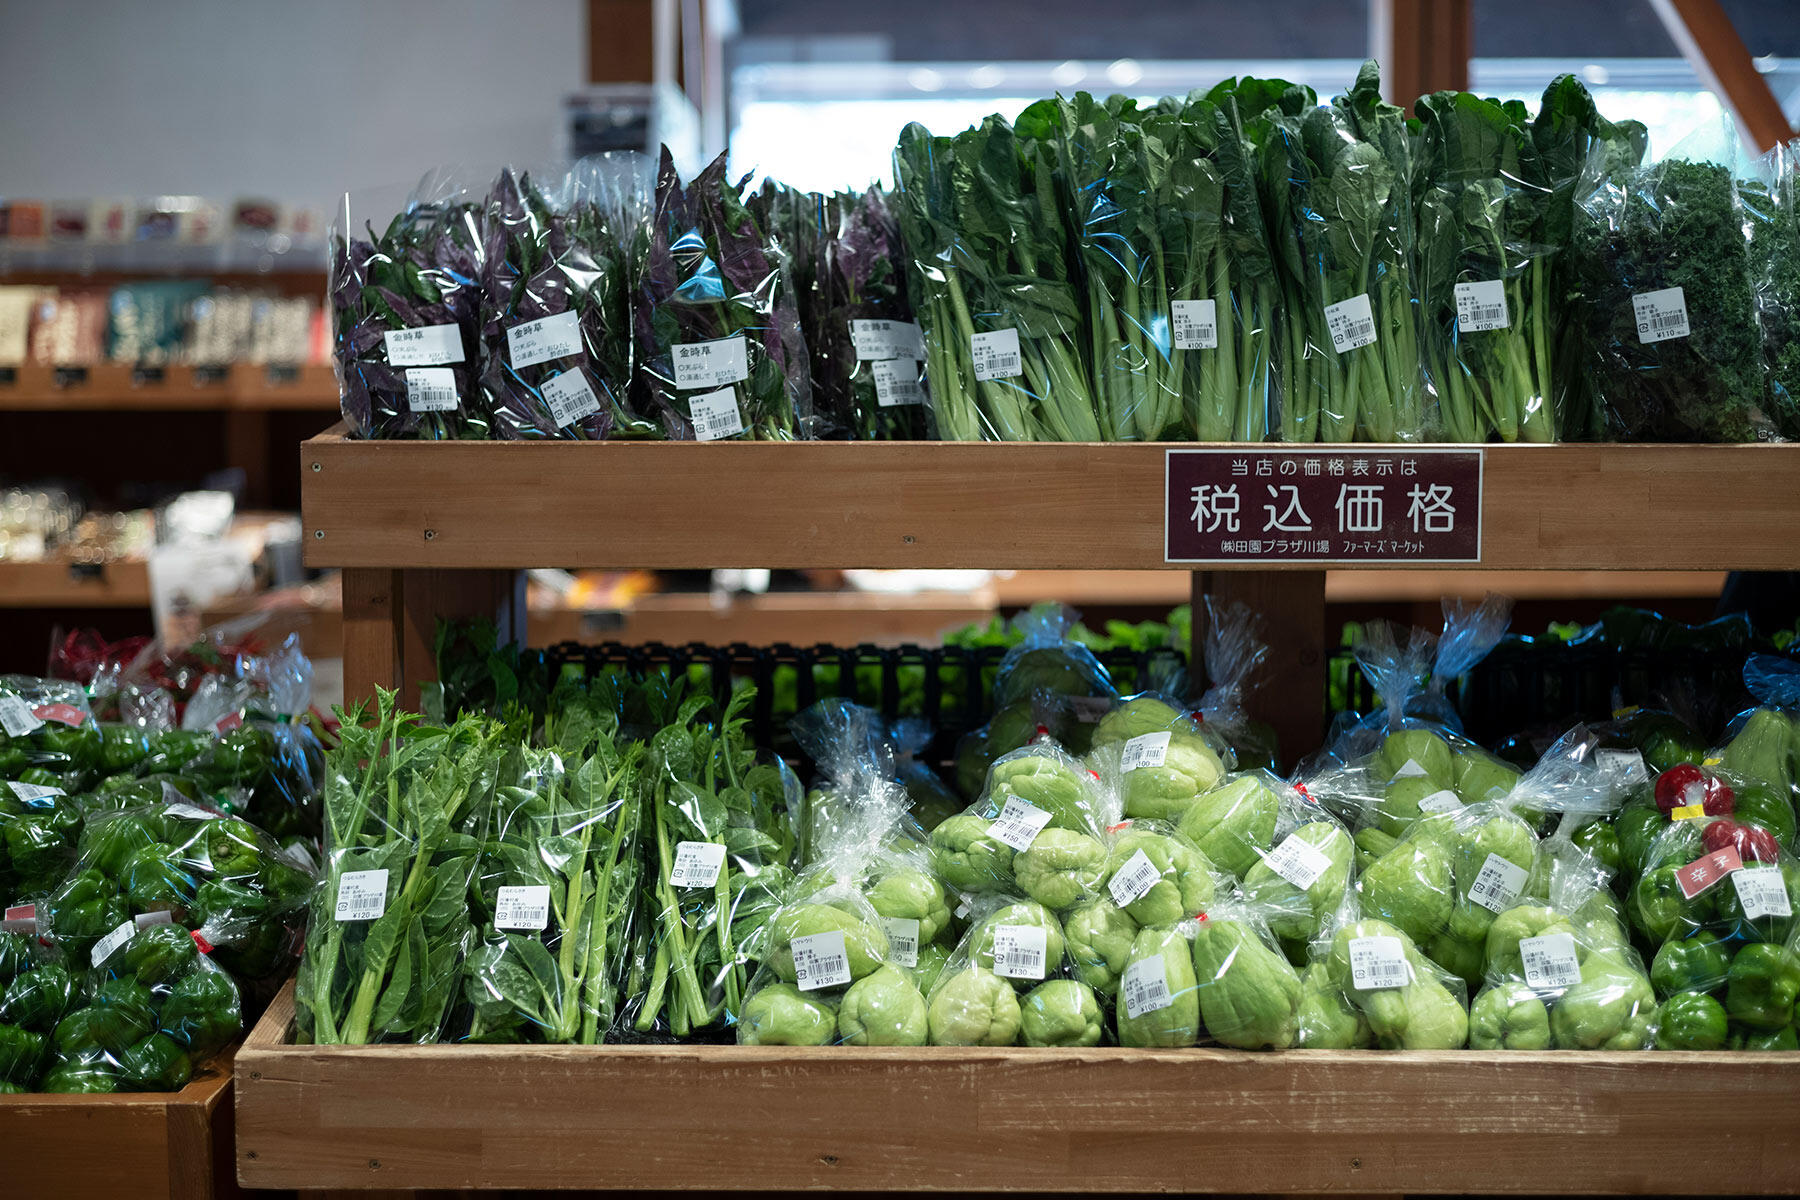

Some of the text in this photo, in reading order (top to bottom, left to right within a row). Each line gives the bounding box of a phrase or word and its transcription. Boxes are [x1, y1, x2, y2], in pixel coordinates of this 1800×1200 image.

[679, 346, 712, 358] 金時草
[1232, 459, 1418, 476] 当店の価格表示は
[1190, 483, 1456, 533] 税込価格
[815, 977, 834, 985] ¥130
